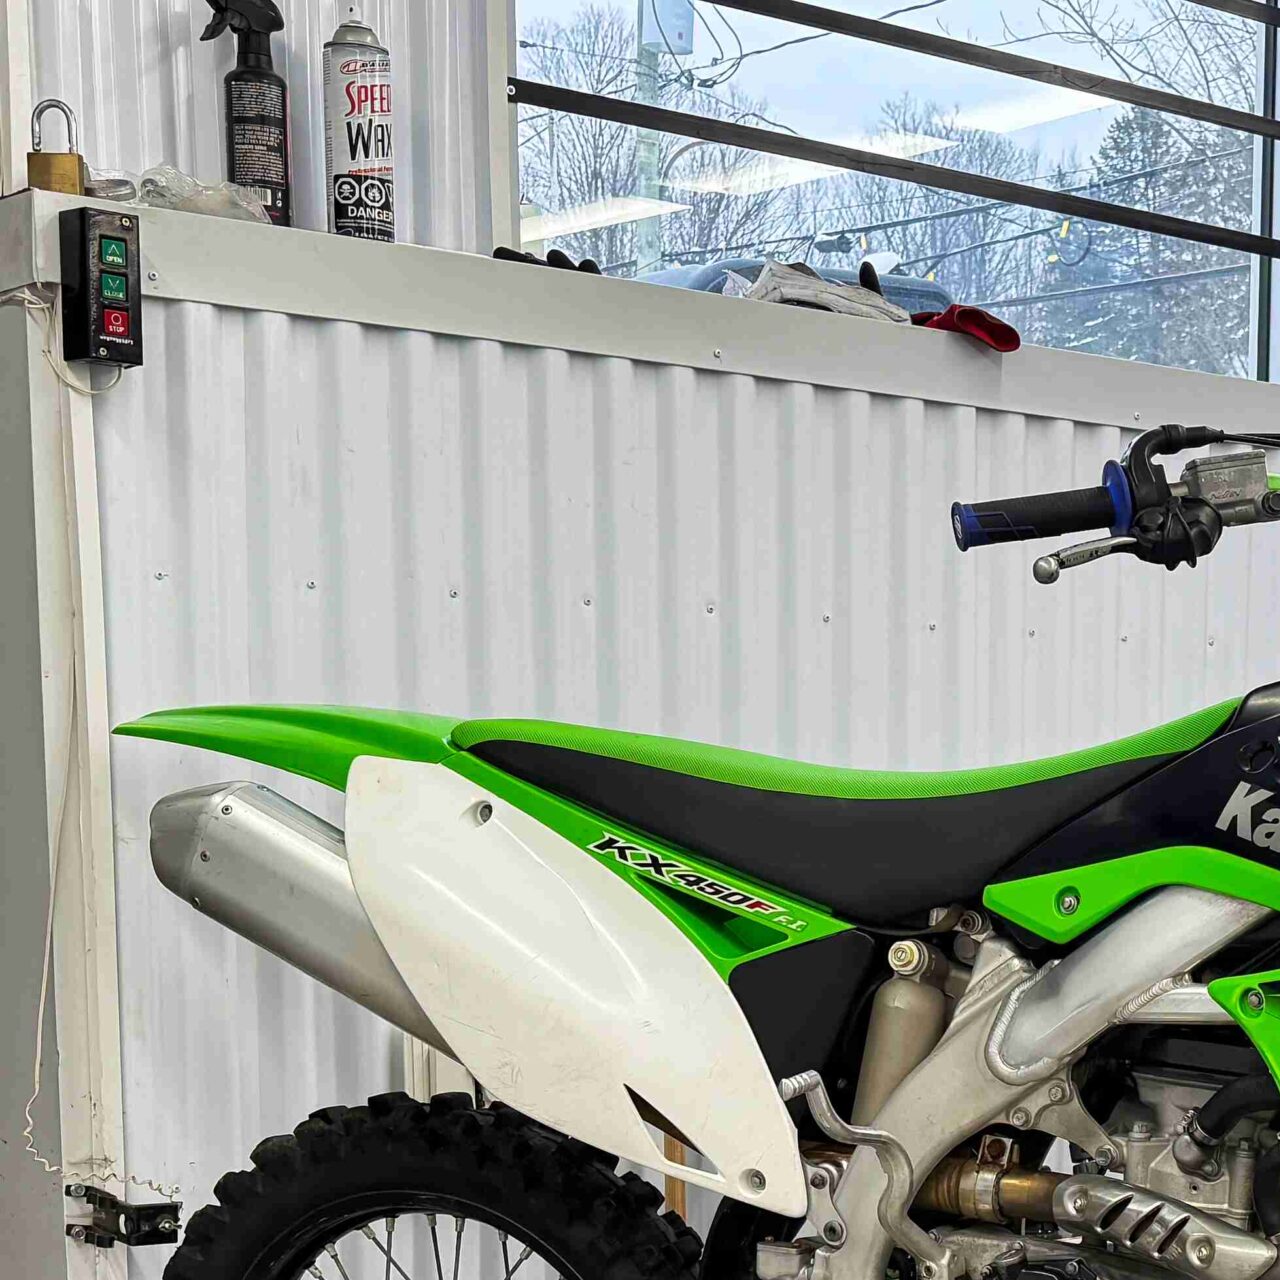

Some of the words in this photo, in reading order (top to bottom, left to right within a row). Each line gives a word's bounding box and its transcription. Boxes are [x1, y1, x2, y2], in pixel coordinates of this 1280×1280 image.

[106, 255, 122, 263] OPEN
[104, 289, 124, 298] CLOSE
[108, 324, 125, 333] STOP
